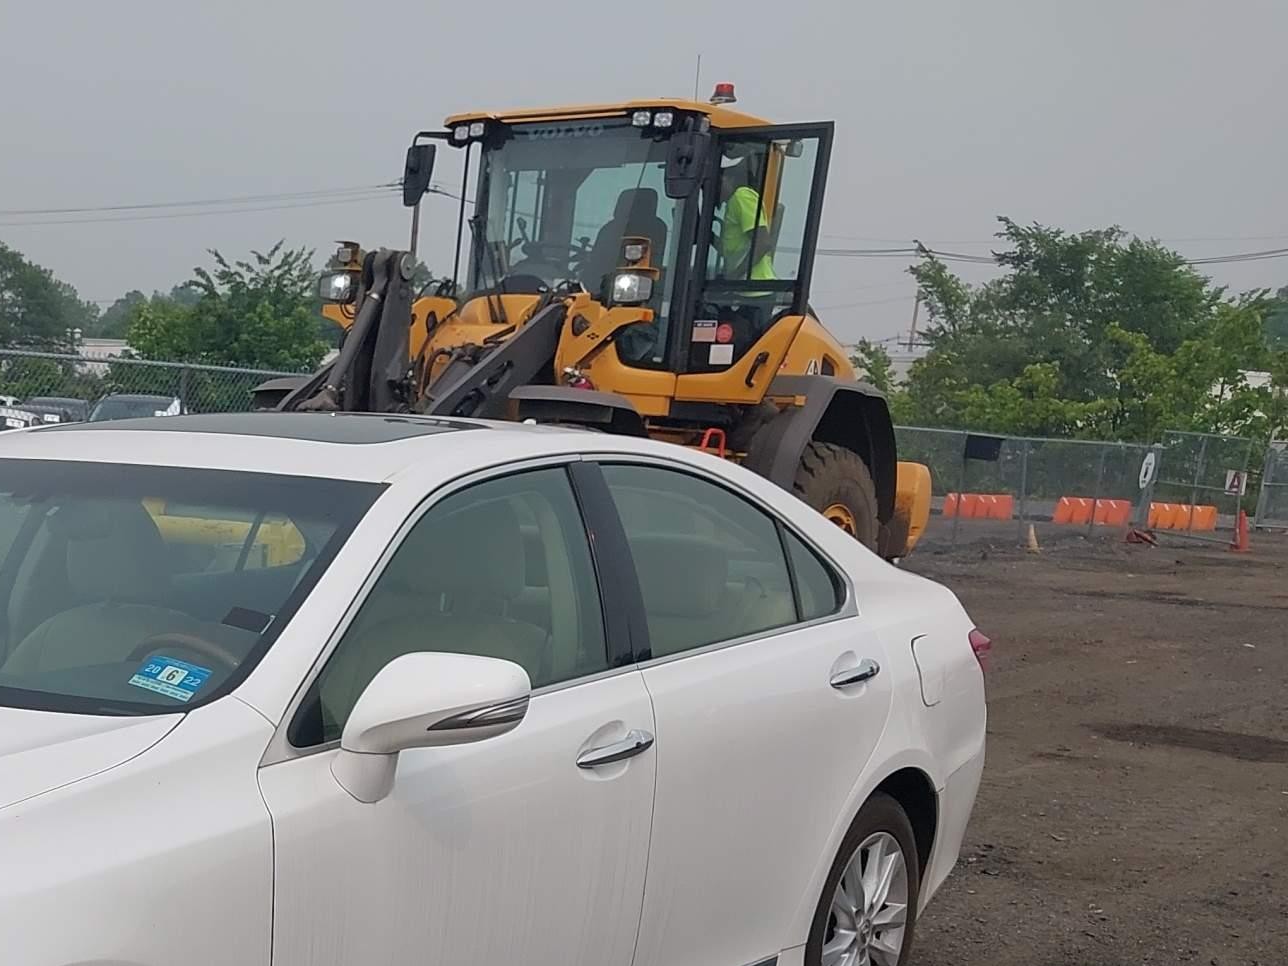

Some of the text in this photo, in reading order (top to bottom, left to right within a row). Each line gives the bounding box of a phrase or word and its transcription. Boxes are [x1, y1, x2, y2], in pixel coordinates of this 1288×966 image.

[145, 664, 162, 674] 20
[166, 669, 179, 681] 6
[183, 676, 201, 687] 22
